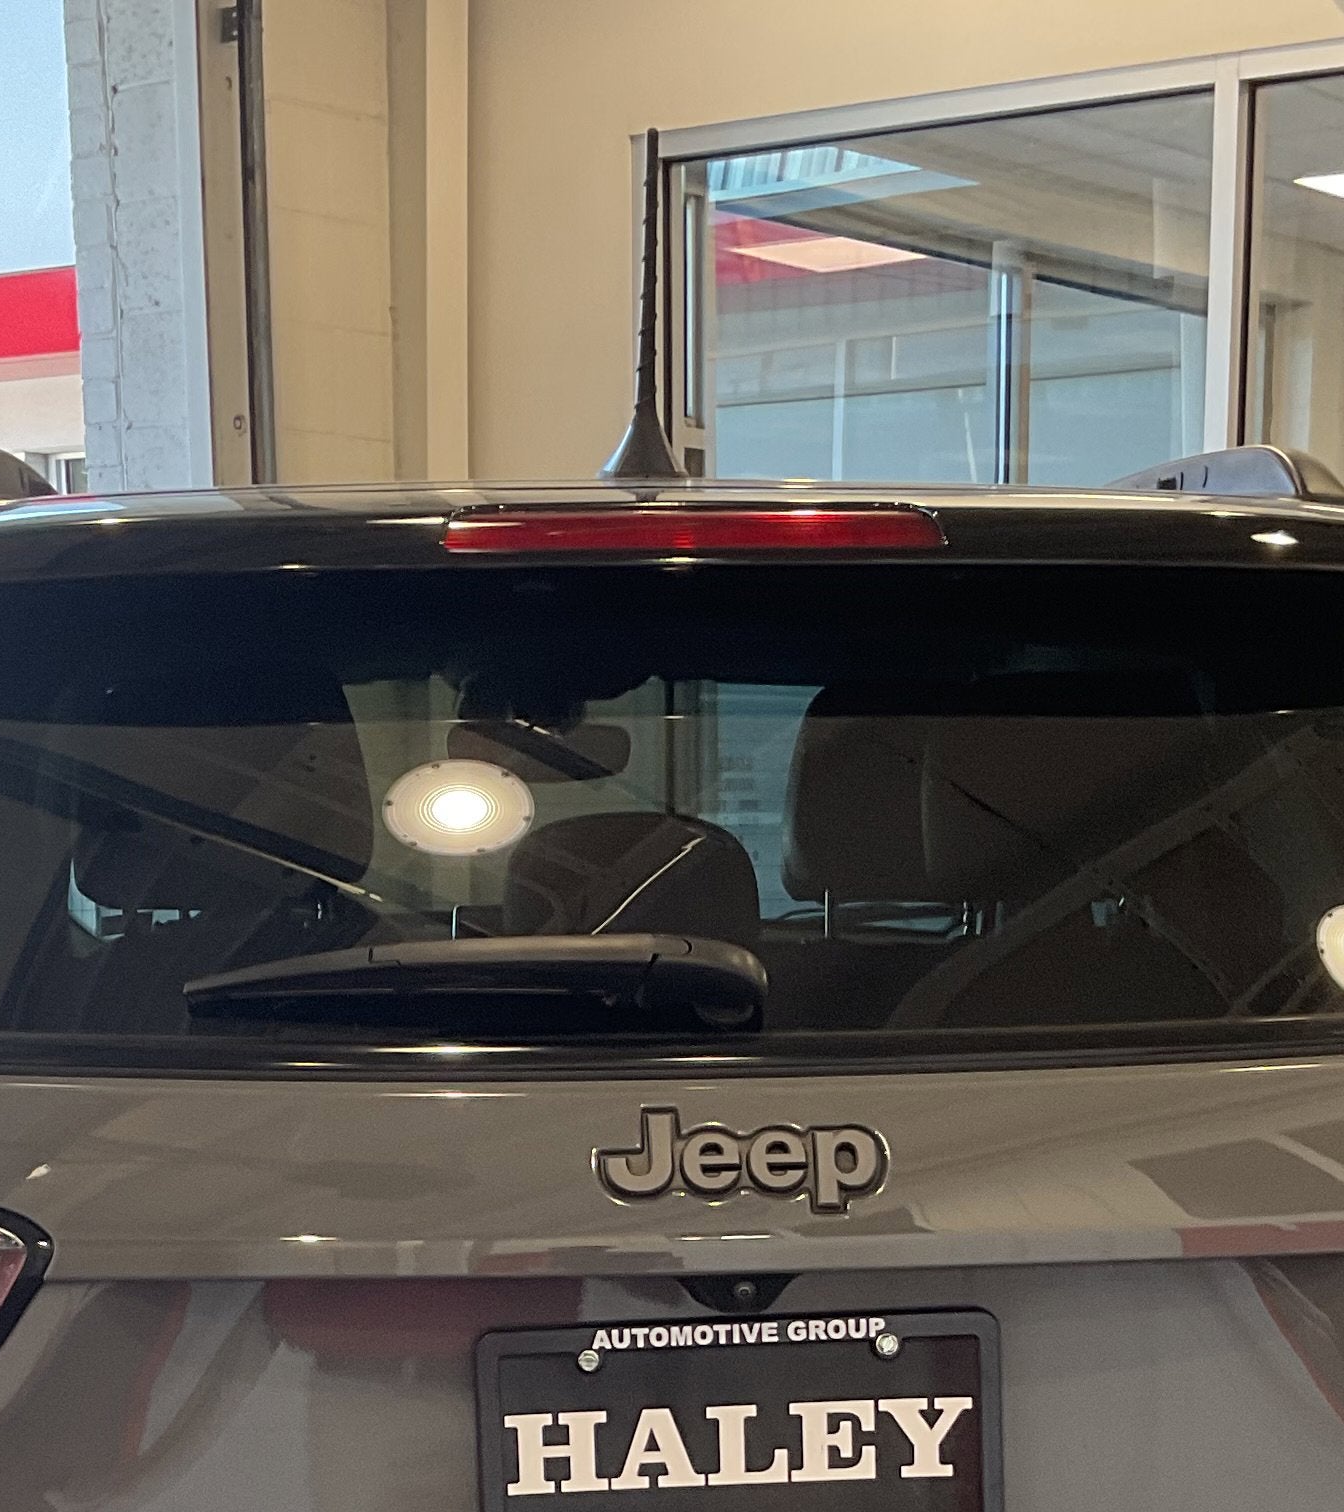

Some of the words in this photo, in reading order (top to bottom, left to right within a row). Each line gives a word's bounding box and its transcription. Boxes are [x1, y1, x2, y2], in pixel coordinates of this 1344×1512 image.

[591, 1104, 890, 1217] Jeep
[592, 1321, 779, 1350] AUTOMOTIVE
[786, 1316, 886, 1342] GROUP
[504, 1396, 974, 1497] HALEY
